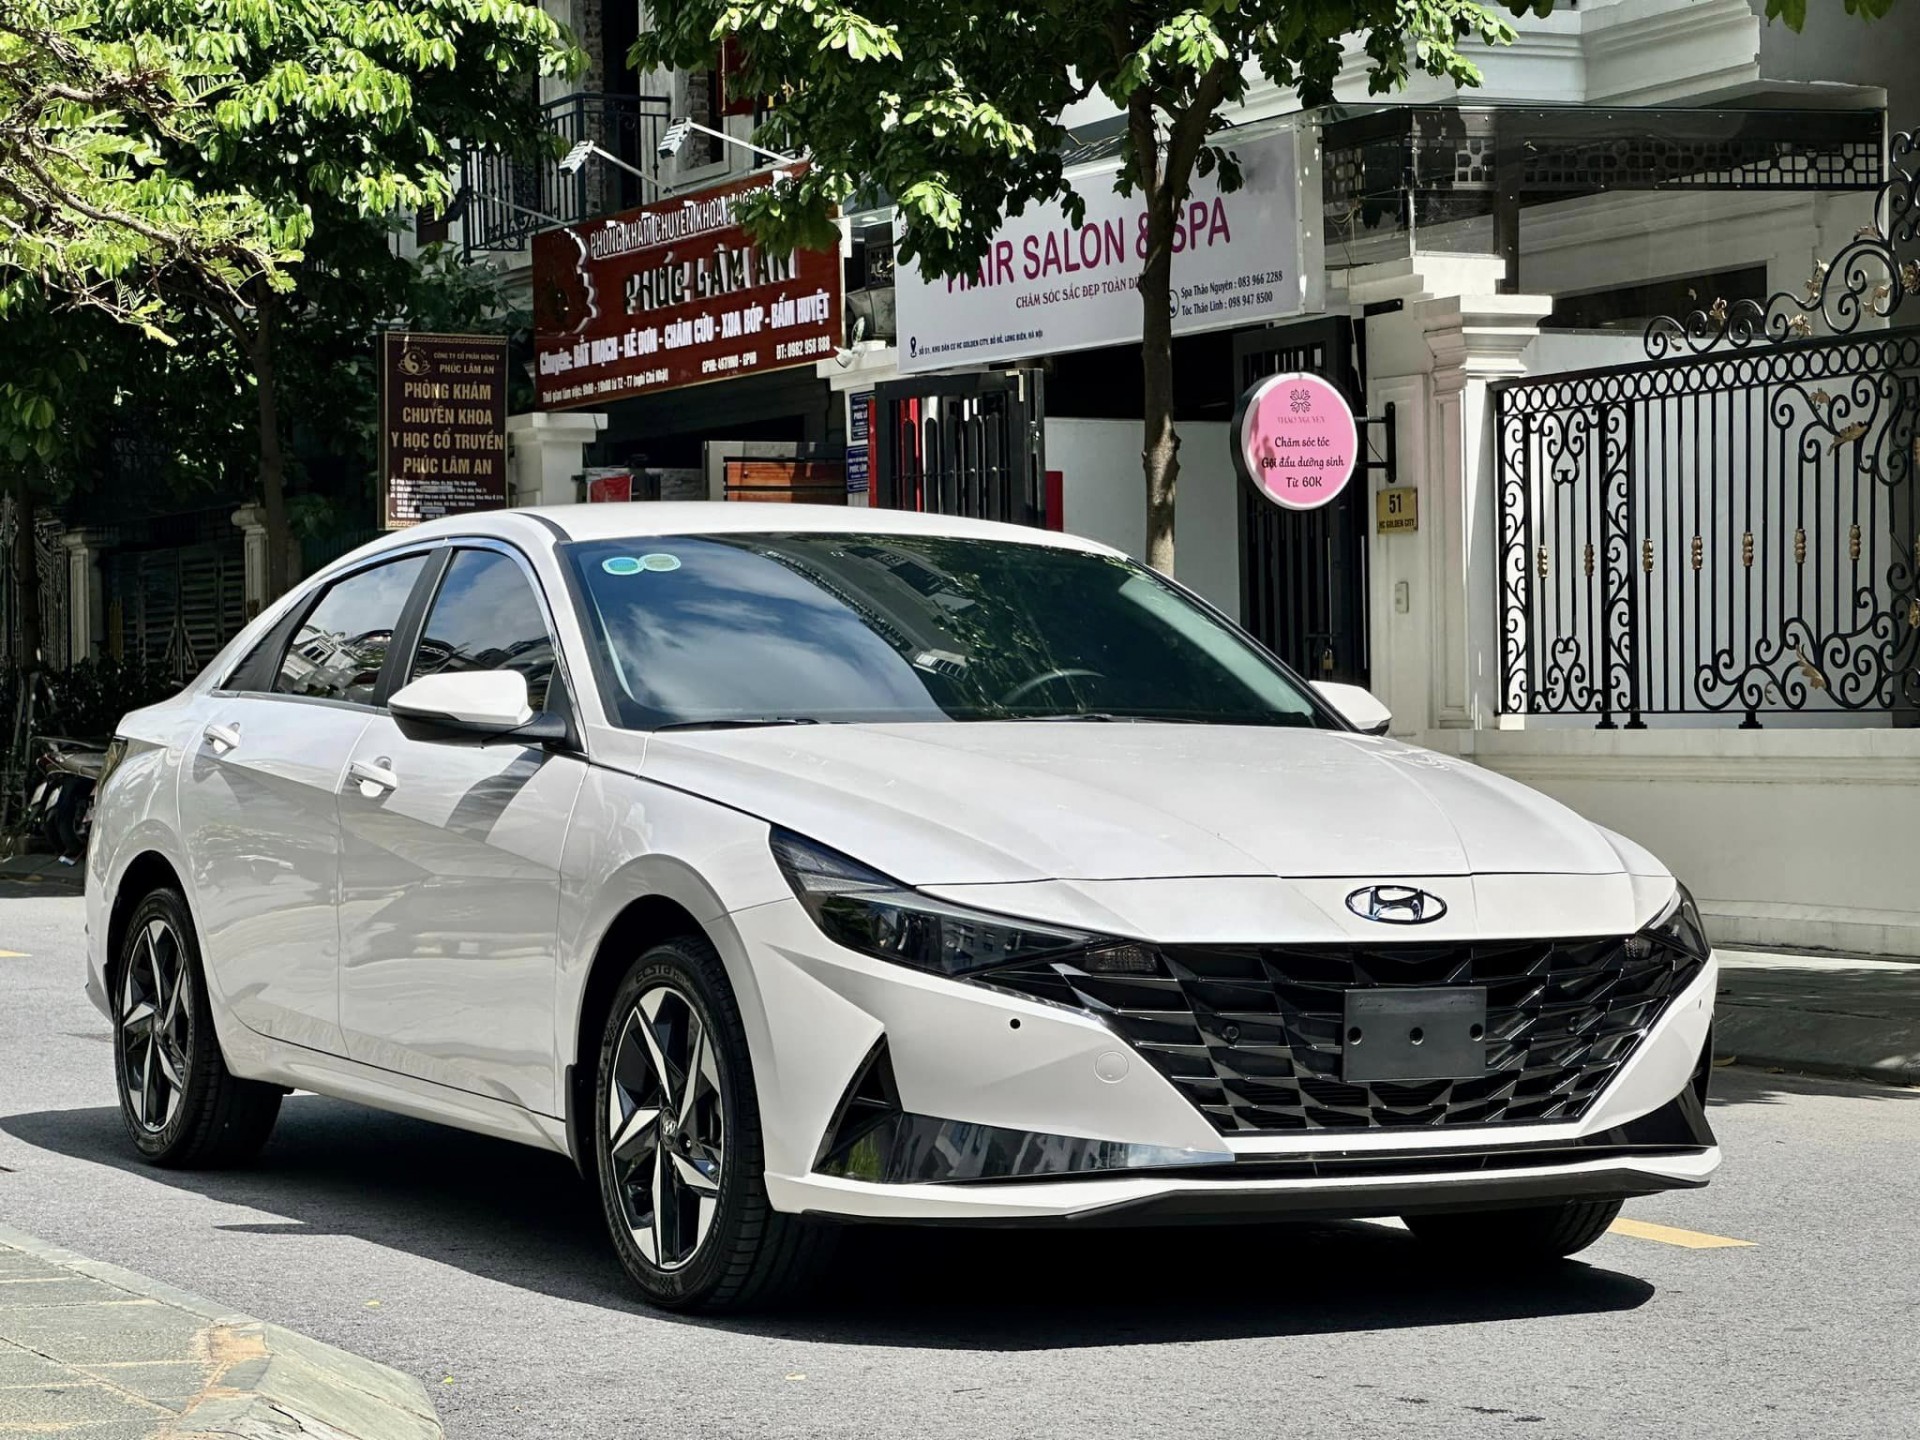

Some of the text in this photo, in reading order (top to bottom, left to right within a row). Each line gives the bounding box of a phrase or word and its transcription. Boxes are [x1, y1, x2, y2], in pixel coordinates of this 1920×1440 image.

[696, 199, 724, 231] KHOA
[1023, 217, 1125, 280] SALON
[1171, 196, 1231, 254] SPA
[626, 251, 690, 315] PHÚC
[1015, 292, 1041, 308] CHĂM
[1042, 288, 1061, 304] SÓC
[1062, 282, 1081, 301] SẮC
[1082, 283, 1100, 299] ĐẸP
[1101, 276, 1127, 294] TOÀN
[1180, 287, 1193, 299] Spa
[1193, 283, 1209, 296] Thảo
[1209, 280, 1233, 295] Nguyên
[1237, 276, 1250, 288] 083
[1252, 273, 1264, 286] 966
[1193, 302, 1209, 315] Thảo
[1209, 299, 1223, 312] Linh
[1228, 296, 1241, 309] 098
[1242, 294, 1254, 307] 947
[1256, 291, 1273, 304] 8500
[664, 317, 693, 349] CHÂM
[721, 311, 742, 339] XOA
[743, 302, 764, 334] BÓP
[771, 292, 795, 329] BẤM
[797, 288, 830, 325] HUYỆT
[439, 362, 495, 374] PHÚC LÂM AN
[404, 379, 491, 400] PHÒNG KHÁM
[402, 404, 493, 425] CHUYÊN KHOA
[391, 427, 504, 452] Y HỌC CỔ TRUYỀN
[1274, 436, 1330, 448] Chăm sóc tóc
[403, 454, 492, 475] PHÚC LÂM AN
[1261, 456, 1277, 470] Gội
[1297, 455, 1324, 470] dưỡng
[1326, 454, 1344, 467] sinh
[1285, 476, 1322, 488] Từ 60K
[1389, 494, 1401, 513] 51
